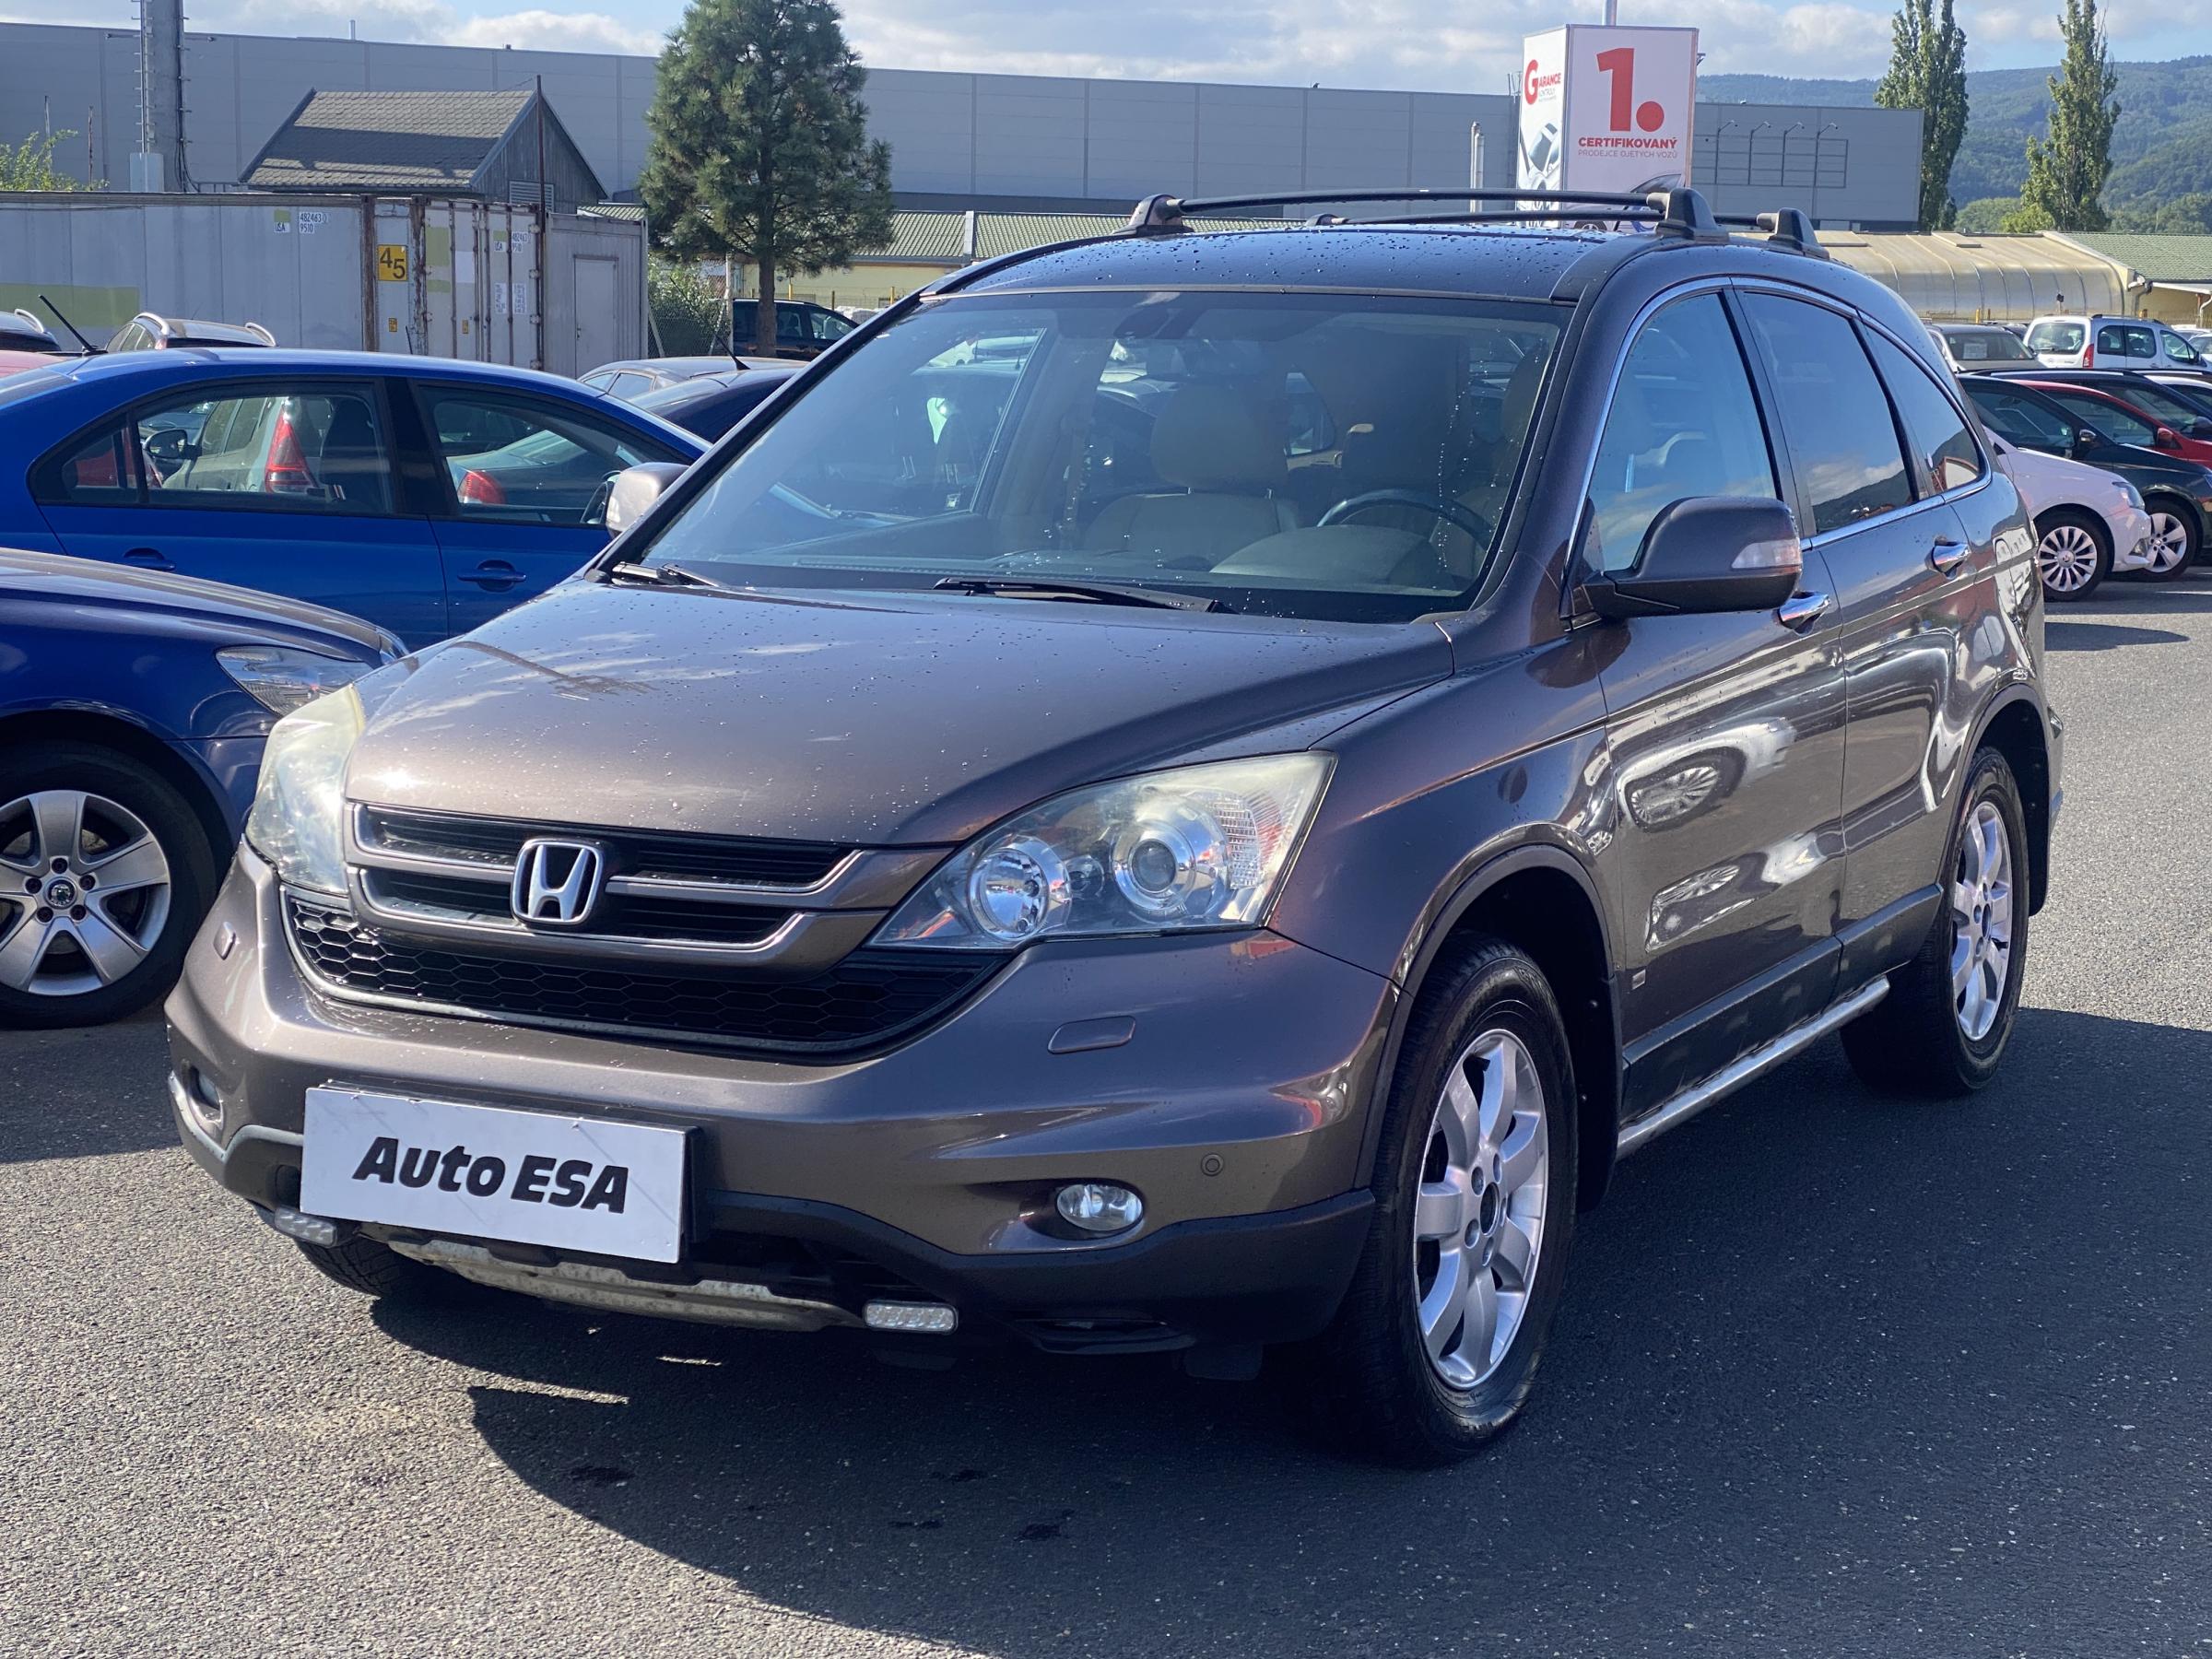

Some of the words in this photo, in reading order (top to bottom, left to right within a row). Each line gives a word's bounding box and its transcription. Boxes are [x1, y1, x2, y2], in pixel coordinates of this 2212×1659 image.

[1578, 136, 1677, 148] CERTIFIKOVANÝ
[1578, 148, 1618, 158] PRODEJCE
[351, 1135, 507, 1198] Auto
[510, 1154, 629, 1215] ESA
